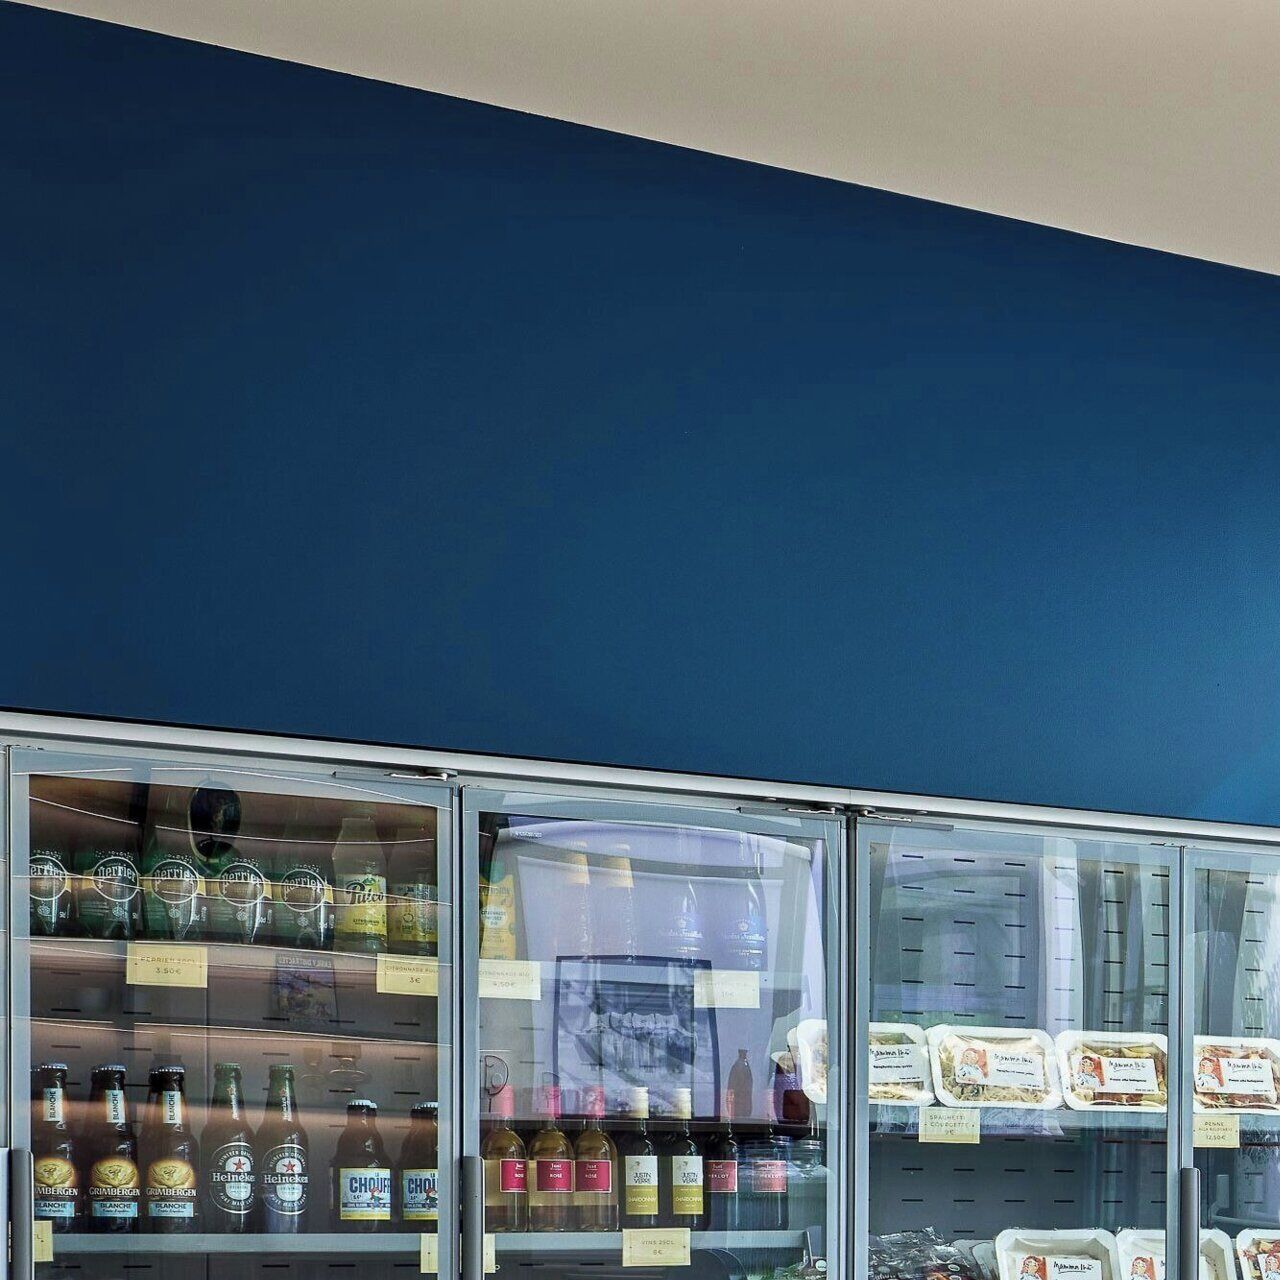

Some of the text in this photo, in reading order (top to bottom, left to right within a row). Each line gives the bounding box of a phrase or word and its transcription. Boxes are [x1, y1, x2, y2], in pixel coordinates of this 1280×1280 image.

[30, 861, 64, 881] errier
[98, 863, 136, 890] perrier
[89, 1187, 141, 1197] GRIMBERGEN
[146, 1188, 197, 1197] GRIMBERGEN
